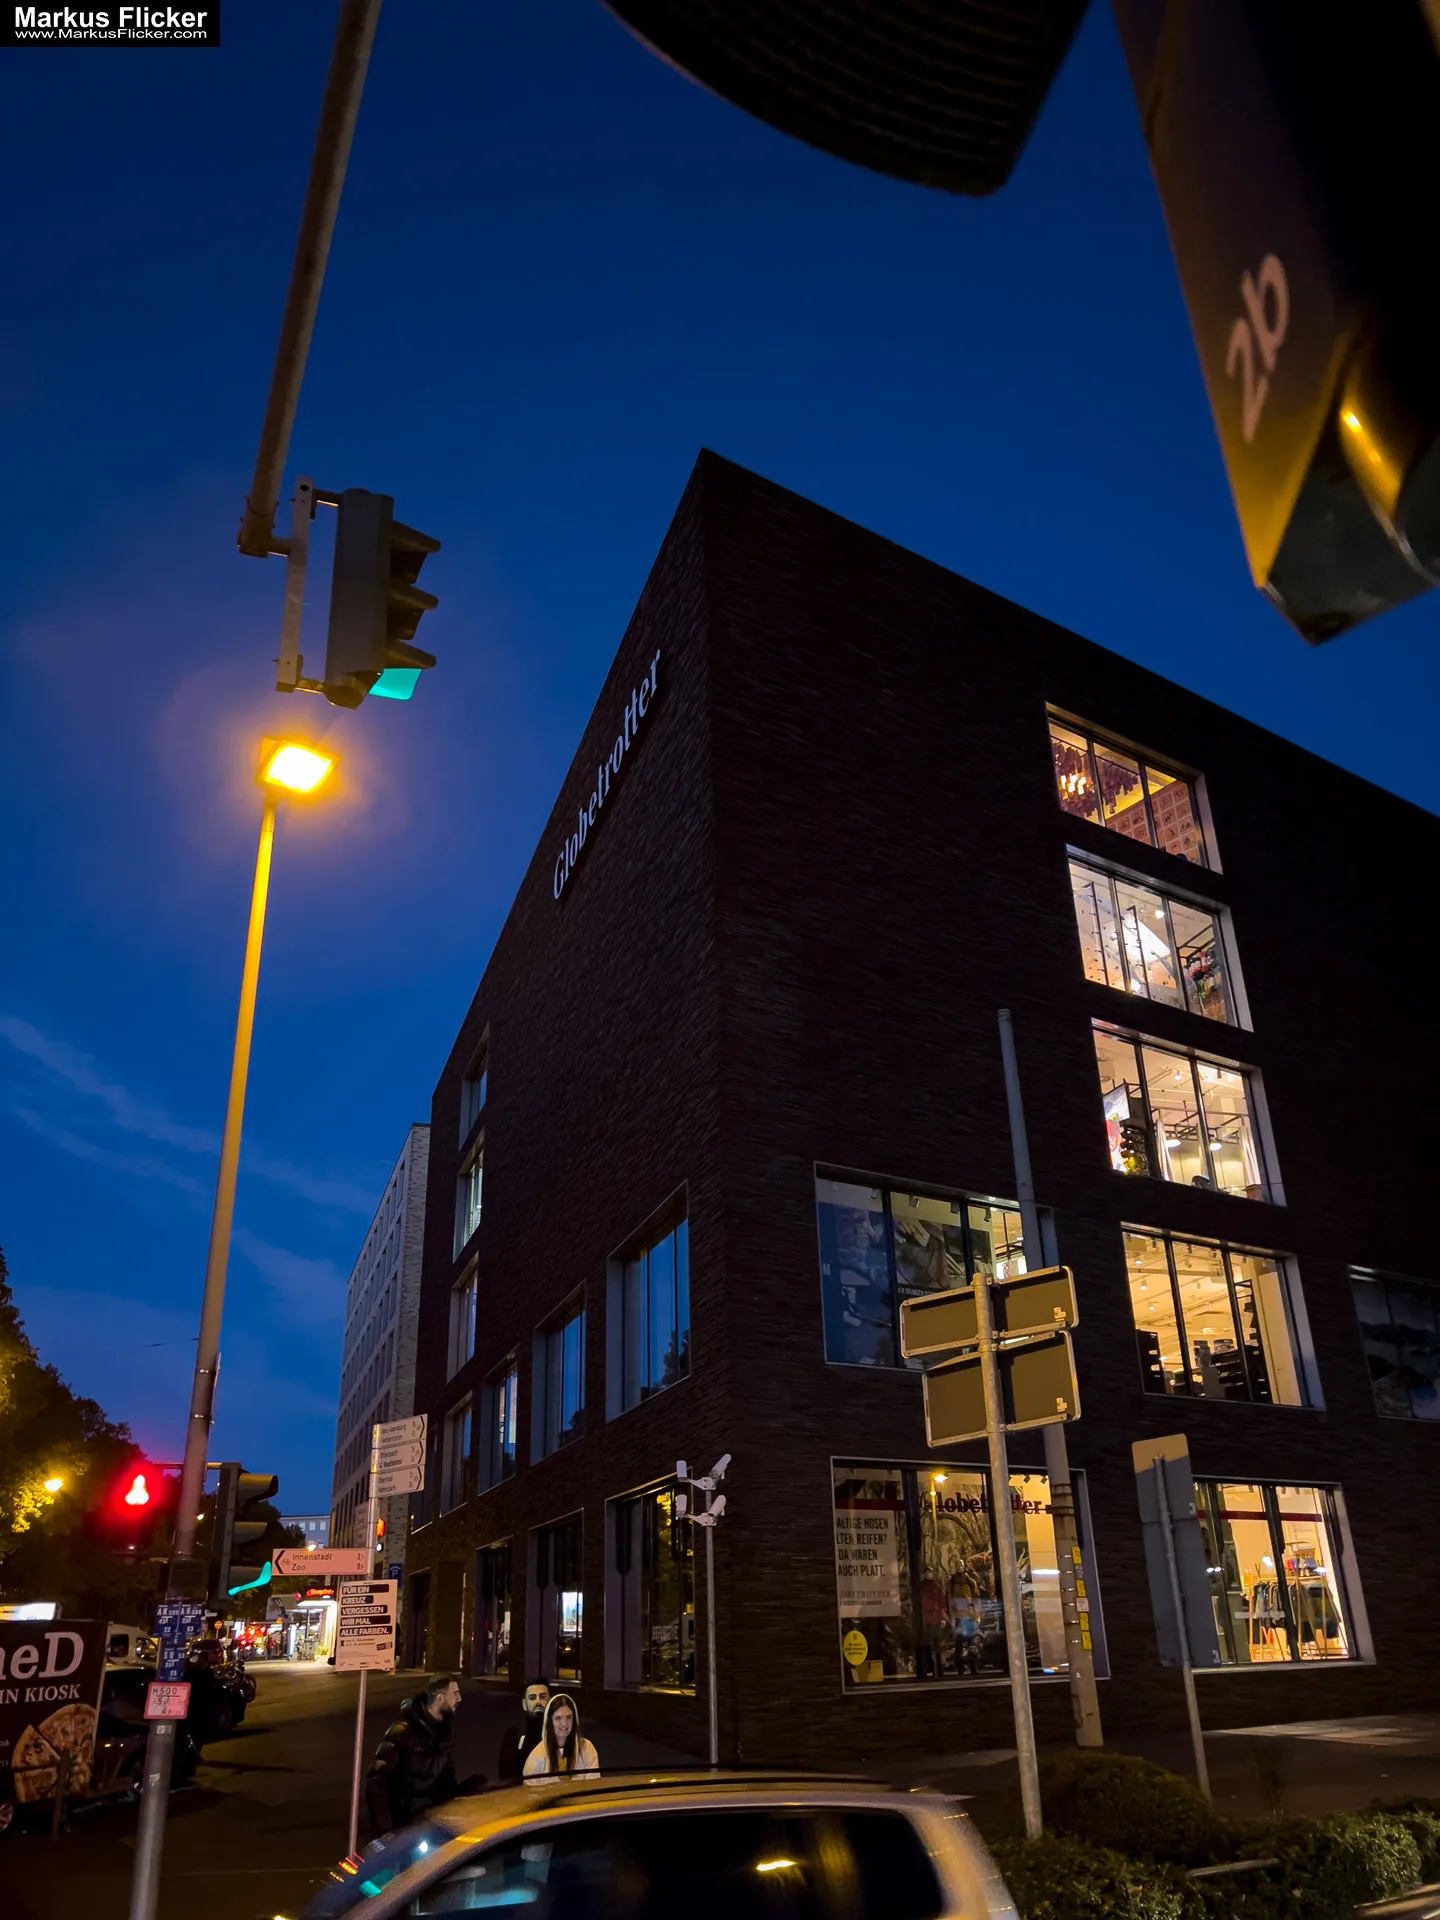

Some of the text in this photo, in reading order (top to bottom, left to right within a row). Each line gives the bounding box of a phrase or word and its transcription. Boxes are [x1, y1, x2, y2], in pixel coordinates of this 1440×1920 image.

[553, 648, 661, 900] Globetrotter
[864, 1518, 889, 1530] HOSEN
[857, 1534, 887, 1545] REIFEN?
[292, 1553, 332, 1561] Innenstadt
[838, 1549, 879, 1561] DA WAREN
[291, 1563, 306, 1571] Zoo
[838, 1564, 886, 1577] AUCH PLATT.
[343, 1586, 370, 1594] FÜR EIN
[342, 1596, 367, 1605] KREUZ
[342, 1606, 384, 1615] VERGESSEN
[341, 1617, 371, 1626] WIR MAL
[340, 1627, 389, 1637] ALLE FARBEN.
[24, 1684, 81, 1703] KIOSK
